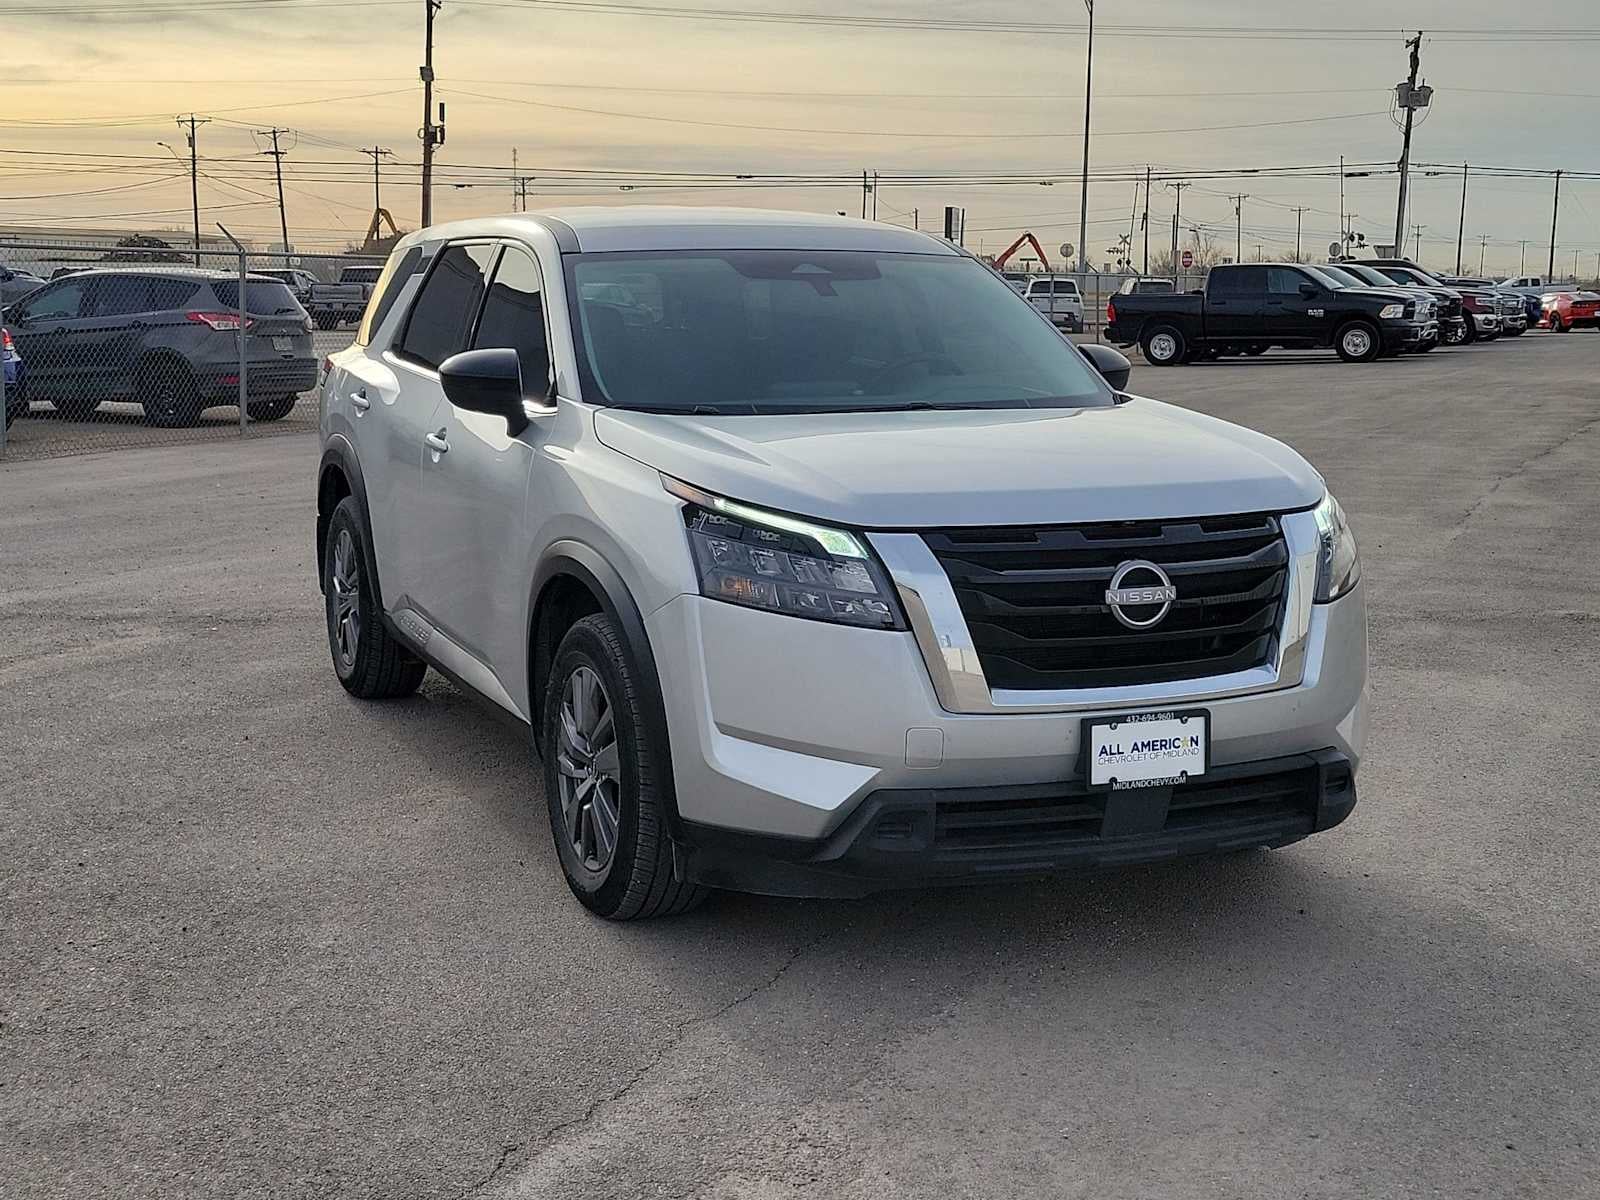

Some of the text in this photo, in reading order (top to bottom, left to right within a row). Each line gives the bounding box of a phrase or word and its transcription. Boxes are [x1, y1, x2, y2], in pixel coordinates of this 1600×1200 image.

[1109, 590, 1175, 602] NISSAN
[1098, 744, 1124, 757] ALL
[1098, 747, 1199, 765] CHEVROLET OF MIDLAND
[1112, 776, 1186, 791] MIDLANDCHEVY.COM
